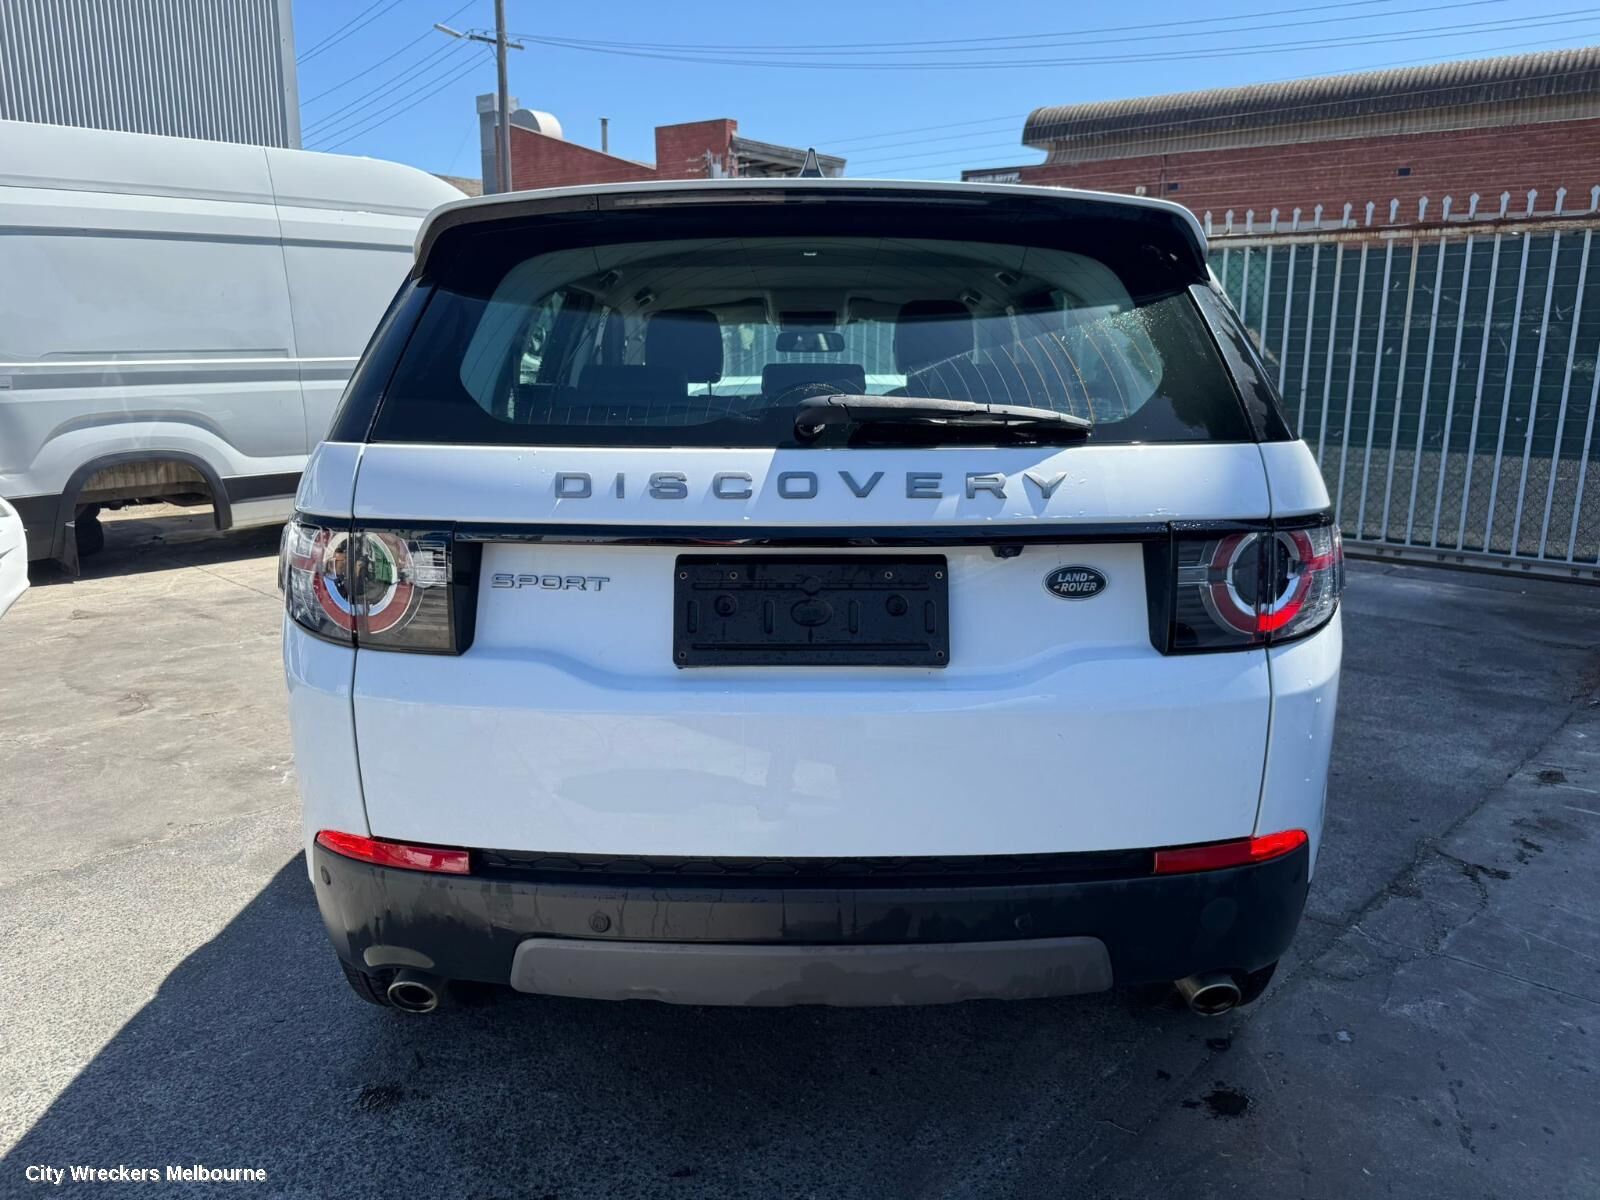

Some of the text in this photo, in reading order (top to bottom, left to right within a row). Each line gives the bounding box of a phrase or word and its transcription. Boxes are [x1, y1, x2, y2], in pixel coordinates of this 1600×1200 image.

[554, 471, 1068, 499] DISCOVERY
[491, 573, 610, 591] SPORT
[1057, 572, 1088, 582] LAND
[1060, 582, 1098, 592] ROVER
